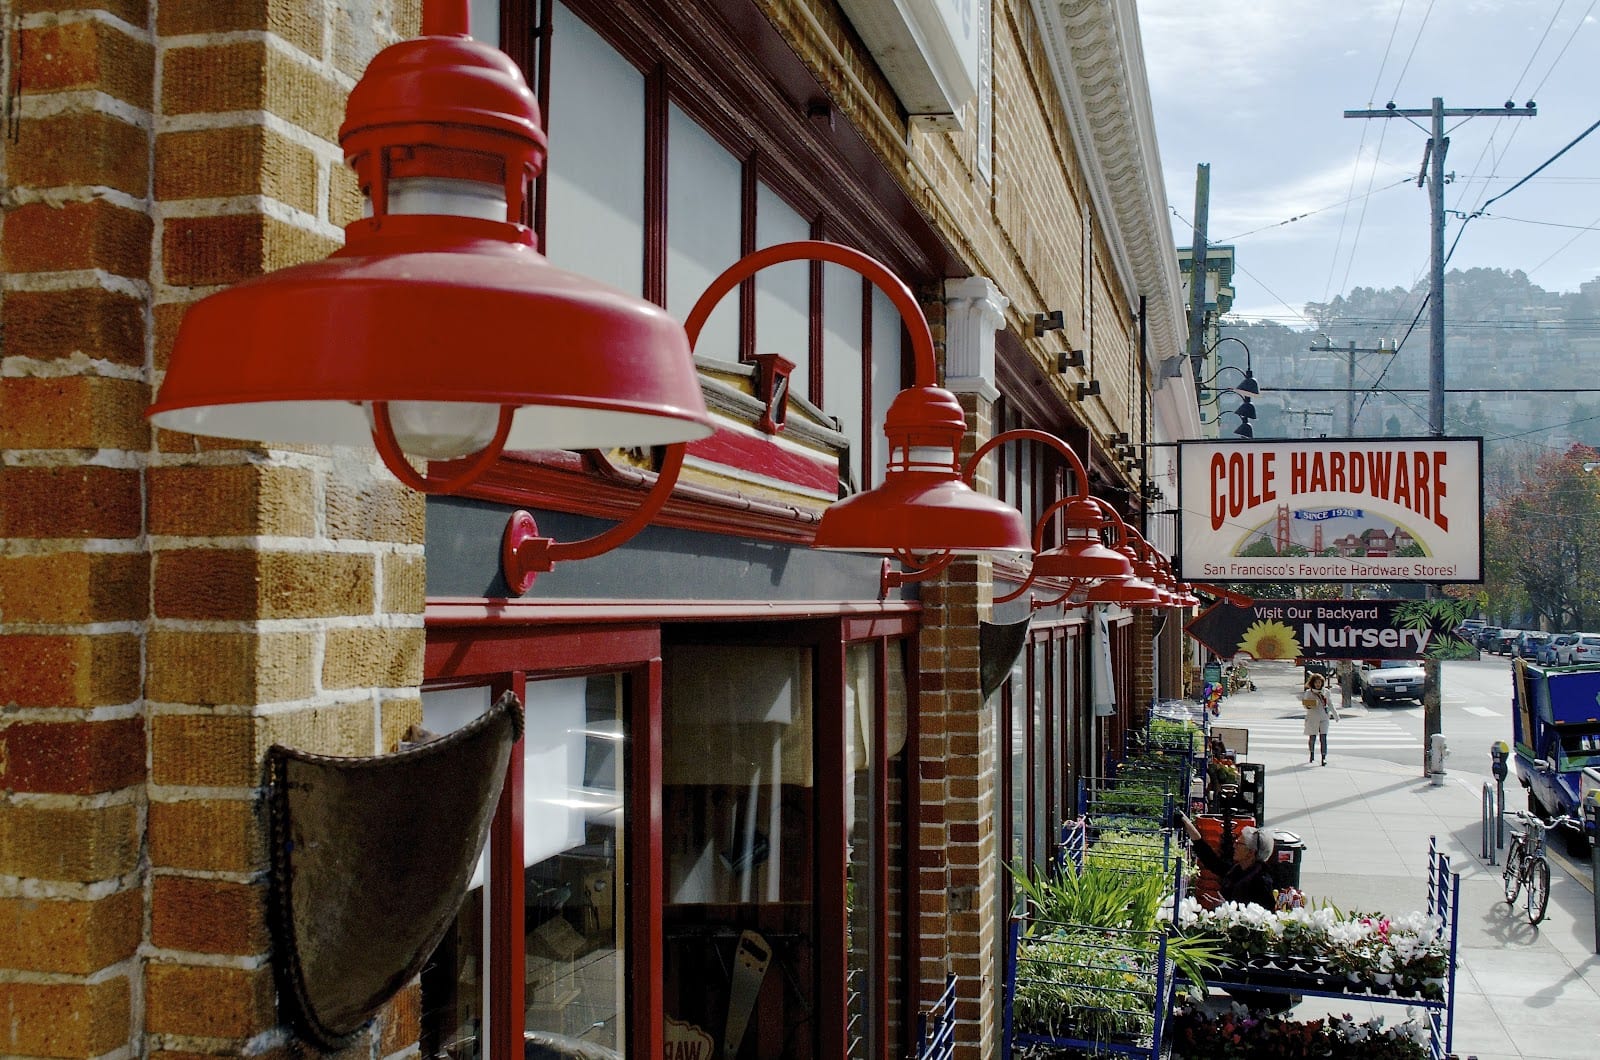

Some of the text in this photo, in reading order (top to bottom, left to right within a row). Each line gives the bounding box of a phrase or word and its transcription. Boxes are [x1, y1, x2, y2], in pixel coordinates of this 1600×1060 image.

[1211, 451, 1448, 533] COLE HARDWARE
[1303, 509, 1354, 520] SINCE 1920
[1204, 563, 1457, 576] San Francisco's Favorite Hardware Stores!
[1254, 607, 1378, 622] Visit Our Backyard
[1303, 623, 1432, 654] Nursery
